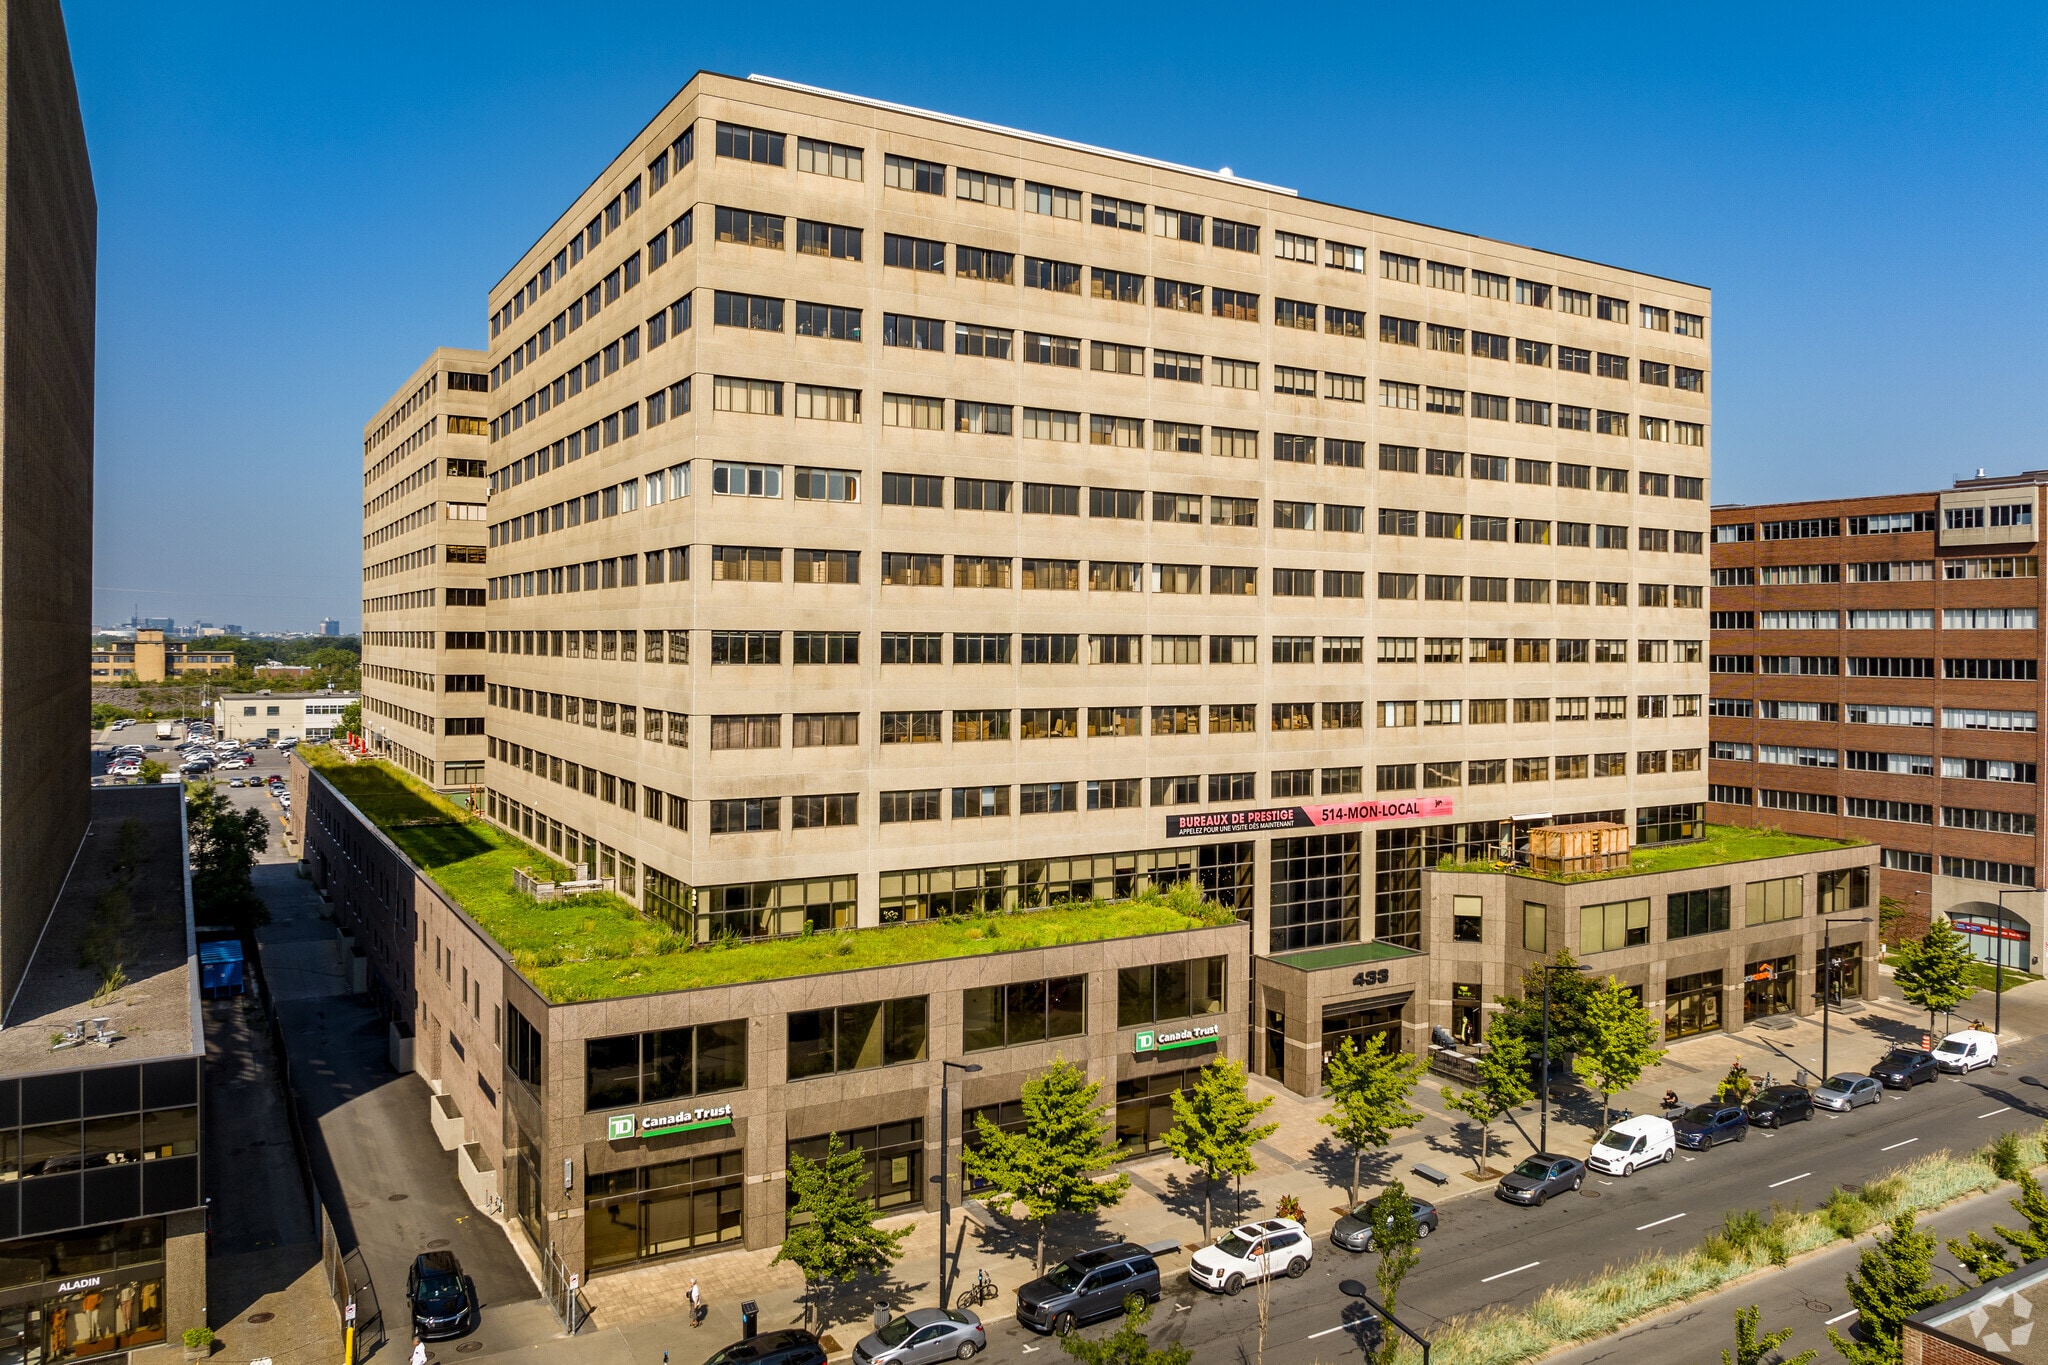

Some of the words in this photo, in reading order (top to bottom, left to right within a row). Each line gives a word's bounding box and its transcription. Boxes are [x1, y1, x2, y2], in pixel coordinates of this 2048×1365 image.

[1179, 815, 1228, 828] BUREAUX
[1231, 813, 1245, 824] DE
[1248, 809, 1294, 823] PRESTIGE
[1322, 802, 1420, 821] 514-MON-LOCAL
[1179, 827, 1203, 835] APPELEZ
[1203, 825, 1219, 833] POUR
[1219, 824, 1231, 832] UNE
[1231, 823, 1248, 831] VISITE
[1260, 820, 1295, 829] MAINTENANT
[1352, 968, 1389, 987] 433
[1158, 1029, 1192, 1043] Canada
[1194, 1024, 1219, 1037] Trust
[641, 1111, 692, 1128] Canada
[694, 1103, 732, 1120] Trust
[611, 1119, 632, 1135] TD
[57, 1276, 100, 1293] ALADIN
